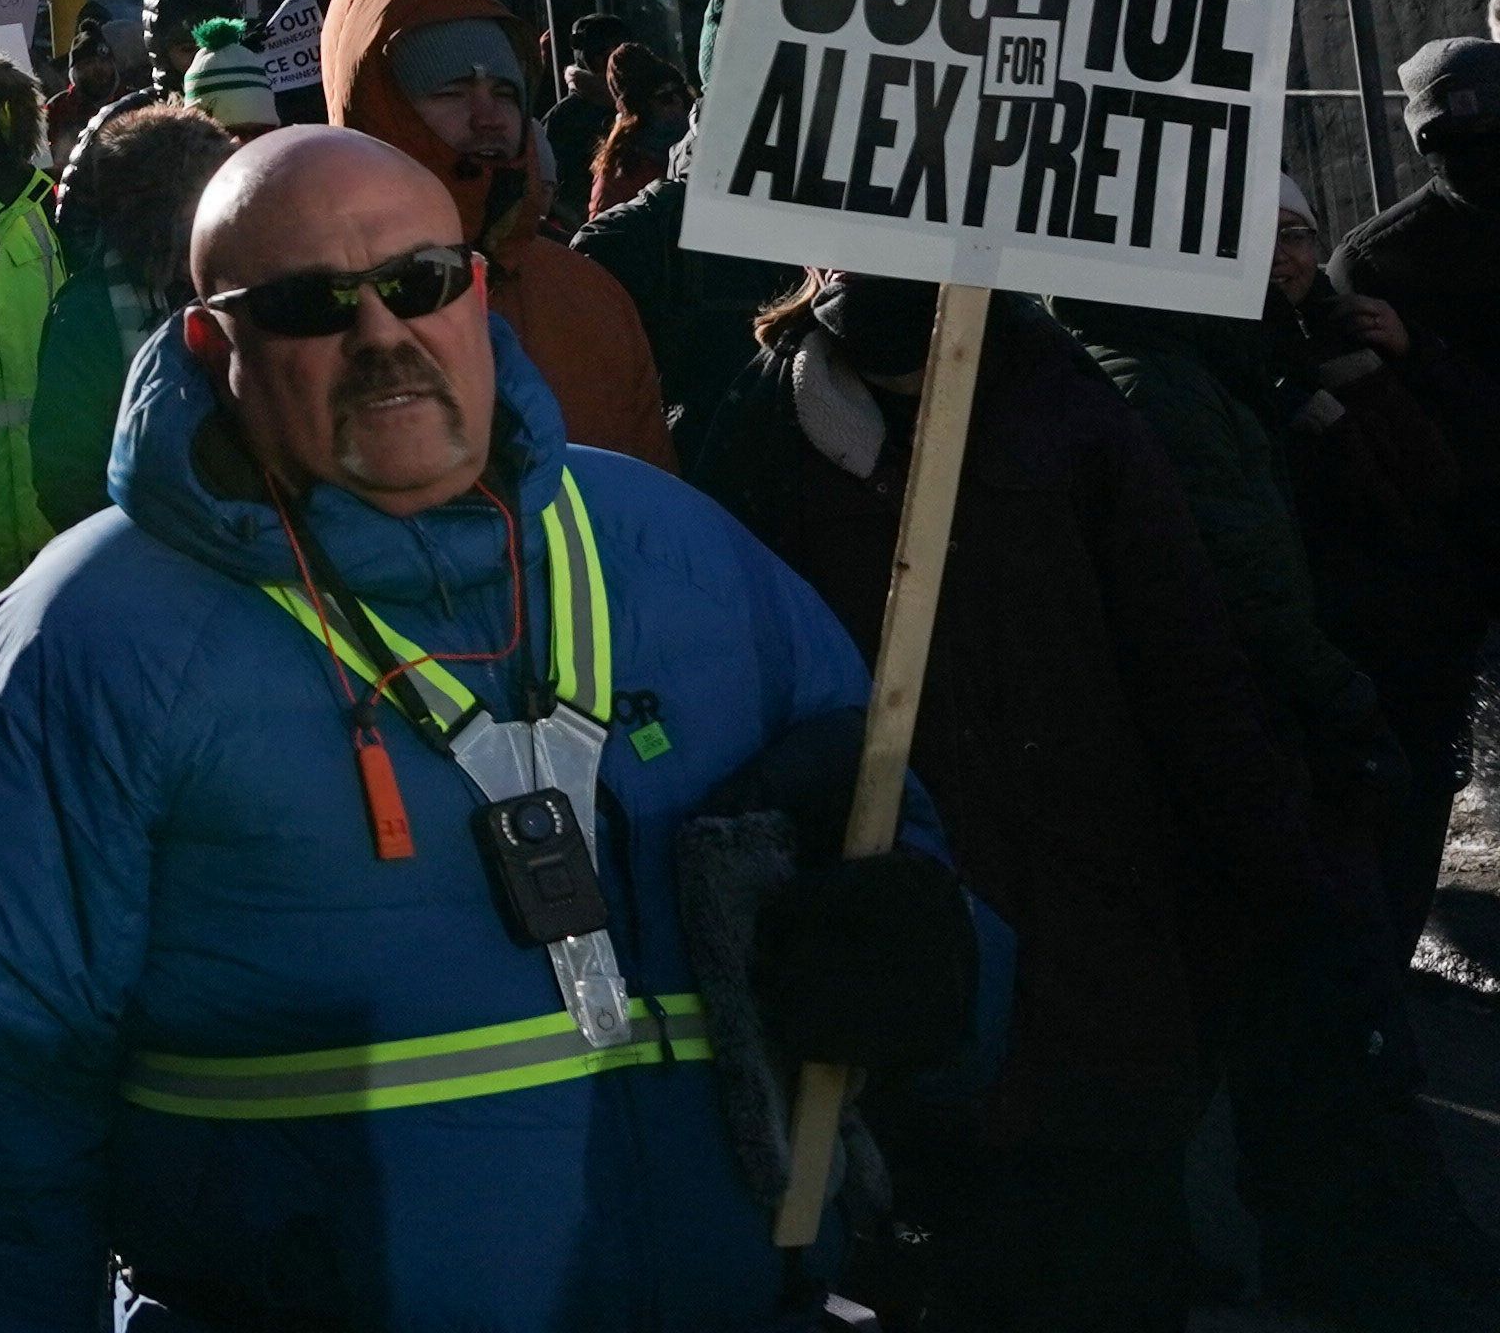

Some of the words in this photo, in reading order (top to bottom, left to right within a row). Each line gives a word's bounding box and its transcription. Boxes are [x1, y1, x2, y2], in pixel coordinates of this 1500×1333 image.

[280, 6, 319, 32] OUT
[265, 56, 290, 74] CE
[293, 47, 321, 67] OU
[997, 31, 1047, 89] FOR
[280, 69, 319, 84] MINNES
[727, 40, 968, 224] ALEX
[961, 79, 1251, 260] PRETTI
